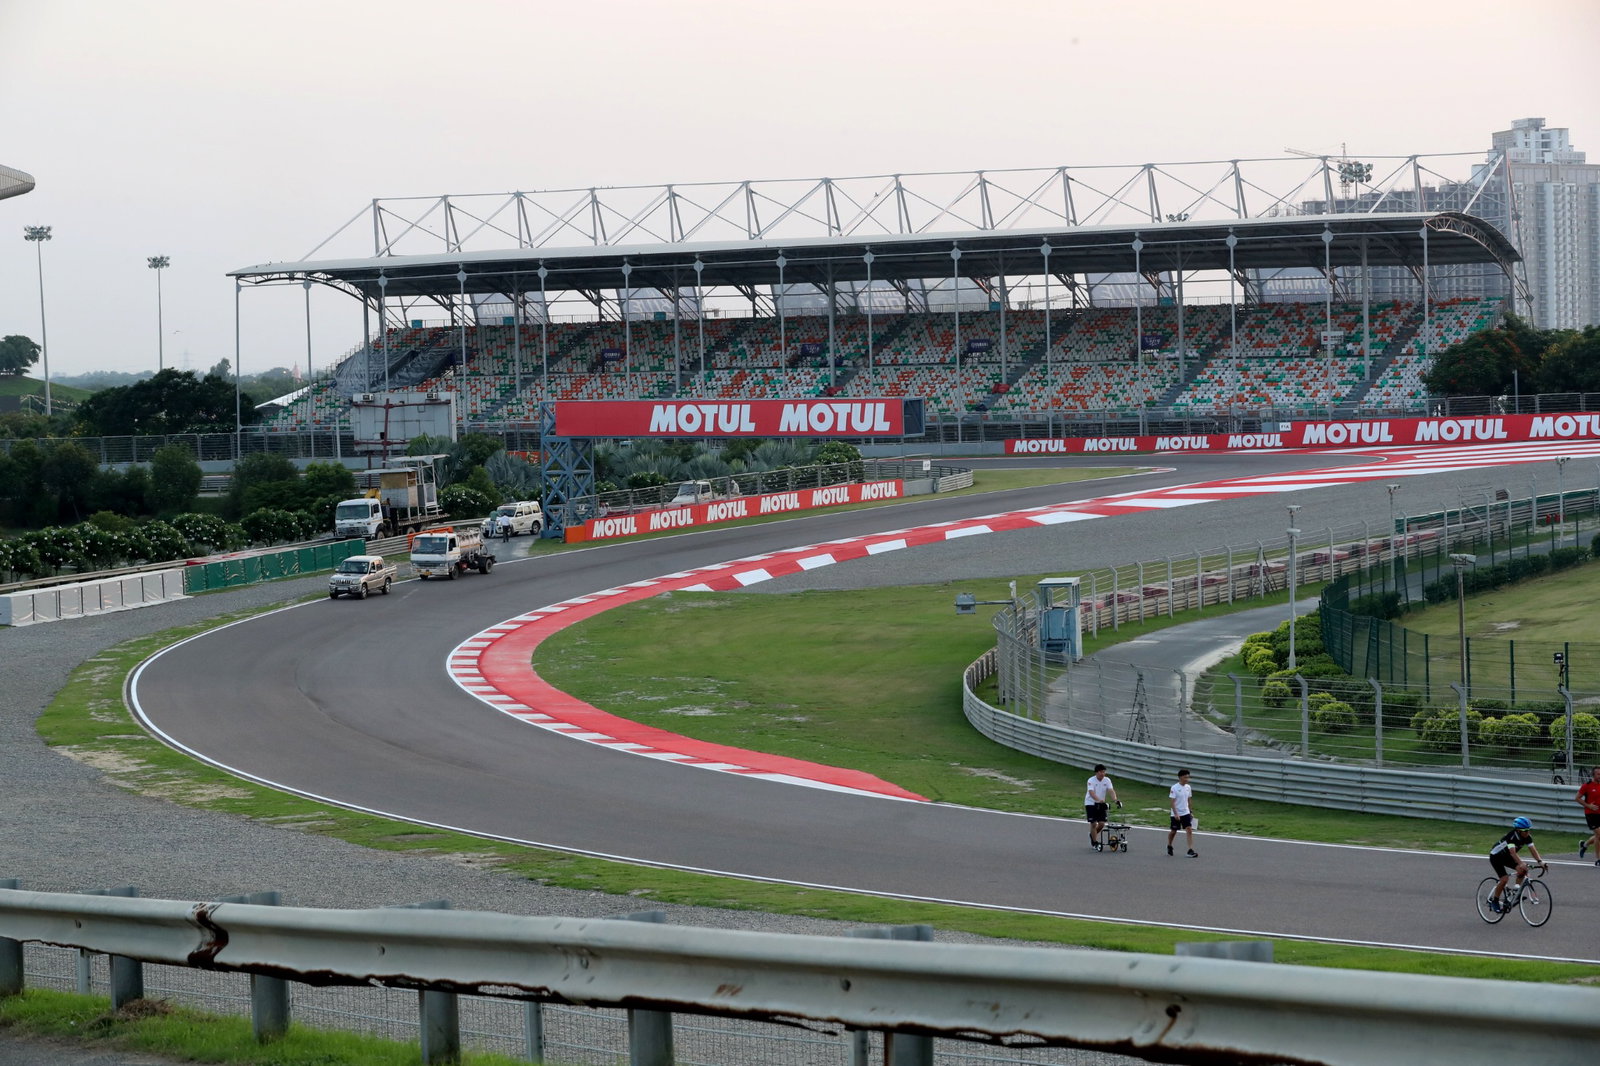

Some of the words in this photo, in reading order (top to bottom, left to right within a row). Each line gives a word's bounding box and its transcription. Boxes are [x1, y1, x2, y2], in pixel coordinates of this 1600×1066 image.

[649, 404, 756, 433] MOTUL
[778, 403, 891, 432] MOTUL
[1302, 422, 1394, 445] MOTUL
[1415, 418, 1508, 442] MOTUL
[1013, 440, 1067, 453] MOTUL
[1083, 438, 1138, 452] MOTUL
[1155, 437, 1210, 450] MOTUL
[1228, 434, 1283, 448] MOTUL
[812, 486, 850, 506] MOTUL
[861, 481, 898, 501] MOTUL
[706, 500, 748, 522] MOTUL
[760, 493, 800, 514] MOTUL
[592, 516, 638, 538] MOTUL
[650, 508, 694, 530] MOTUL
